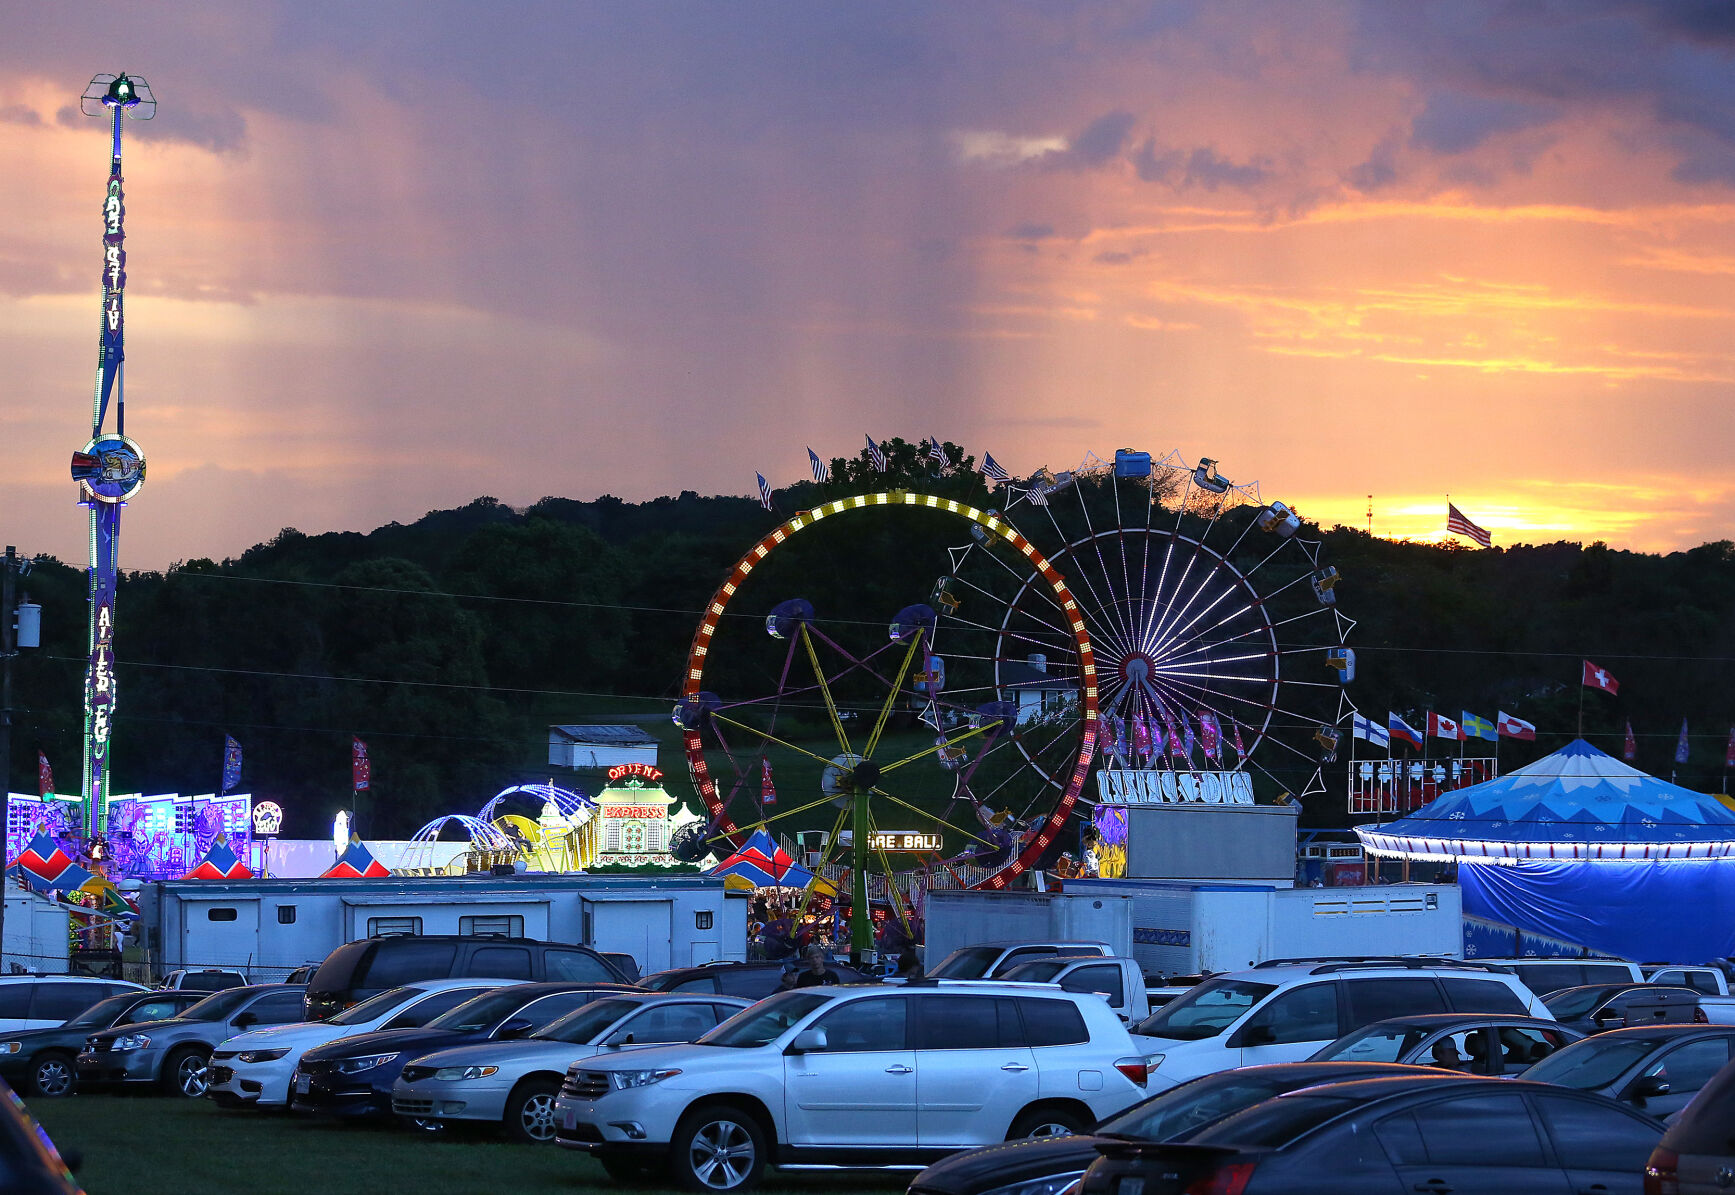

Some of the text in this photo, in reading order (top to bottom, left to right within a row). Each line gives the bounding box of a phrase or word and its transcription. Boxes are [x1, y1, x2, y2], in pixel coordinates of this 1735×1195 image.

[105, 179, 121, 234] EGO
[94, 703, 110, 760] EGO
[608, 763, 664, 781] ORIENT
[603, 806, 667, 818] EXPRESS
[867, 835, 941, 848] IRE BALL
